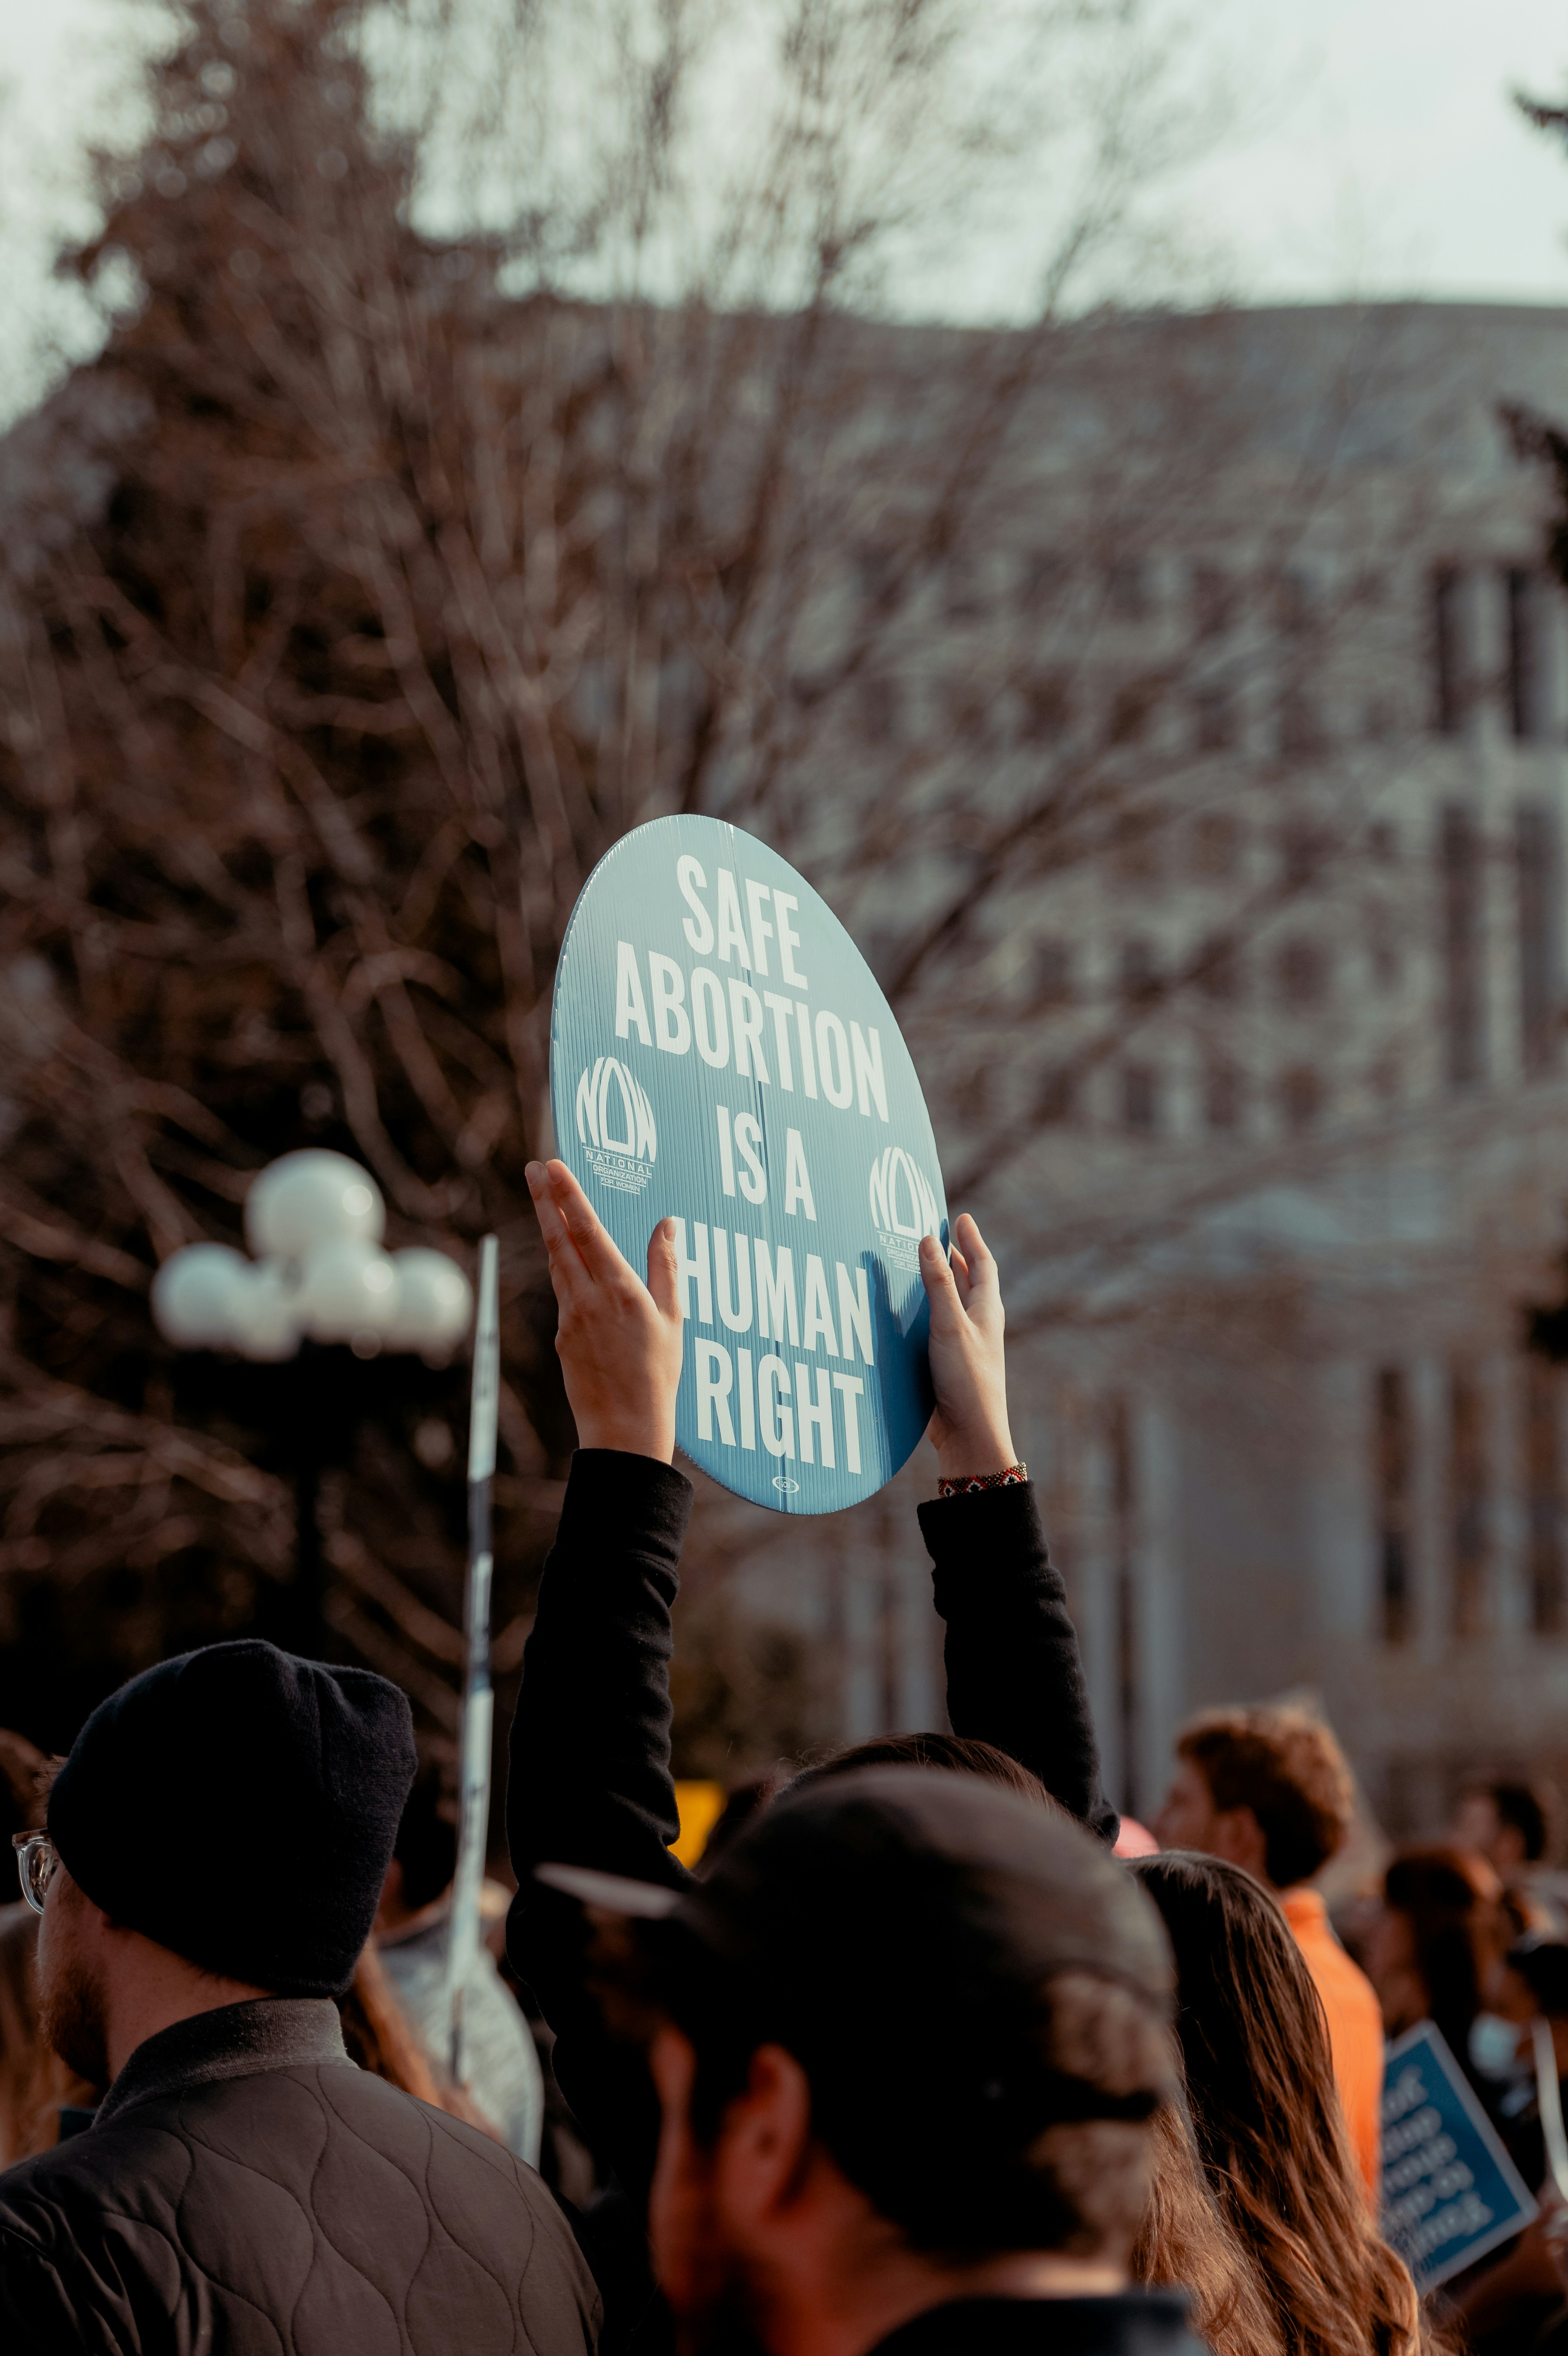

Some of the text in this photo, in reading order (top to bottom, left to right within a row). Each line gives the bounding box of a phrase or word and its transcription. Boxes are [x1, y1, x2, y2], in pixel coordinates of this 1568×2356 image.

[677, 854, 808, 990] SAFE
[615, 941, 889, 1123] ABORTION
[576, 1057, 657, 1163] NOW
[586, 1150, 652, 1176] NATIONAL
[593, 1164, 646, 1185] ORGANIZATION
[601, 1177, 640, 1192] FOR WOMEN
[716, 1105, 817, 1222] IS A
[869, 1147, 940, 1240] NOW
[671, 1215, 874, 1366] HUMAN
[879, 1235, 919, 1253] NATIO
[886, 1248, 919, 1262] ORGANIZA
[907, 1263, 921, 1271] WOM
[695, 1337, 863, 1475] RIGHT
